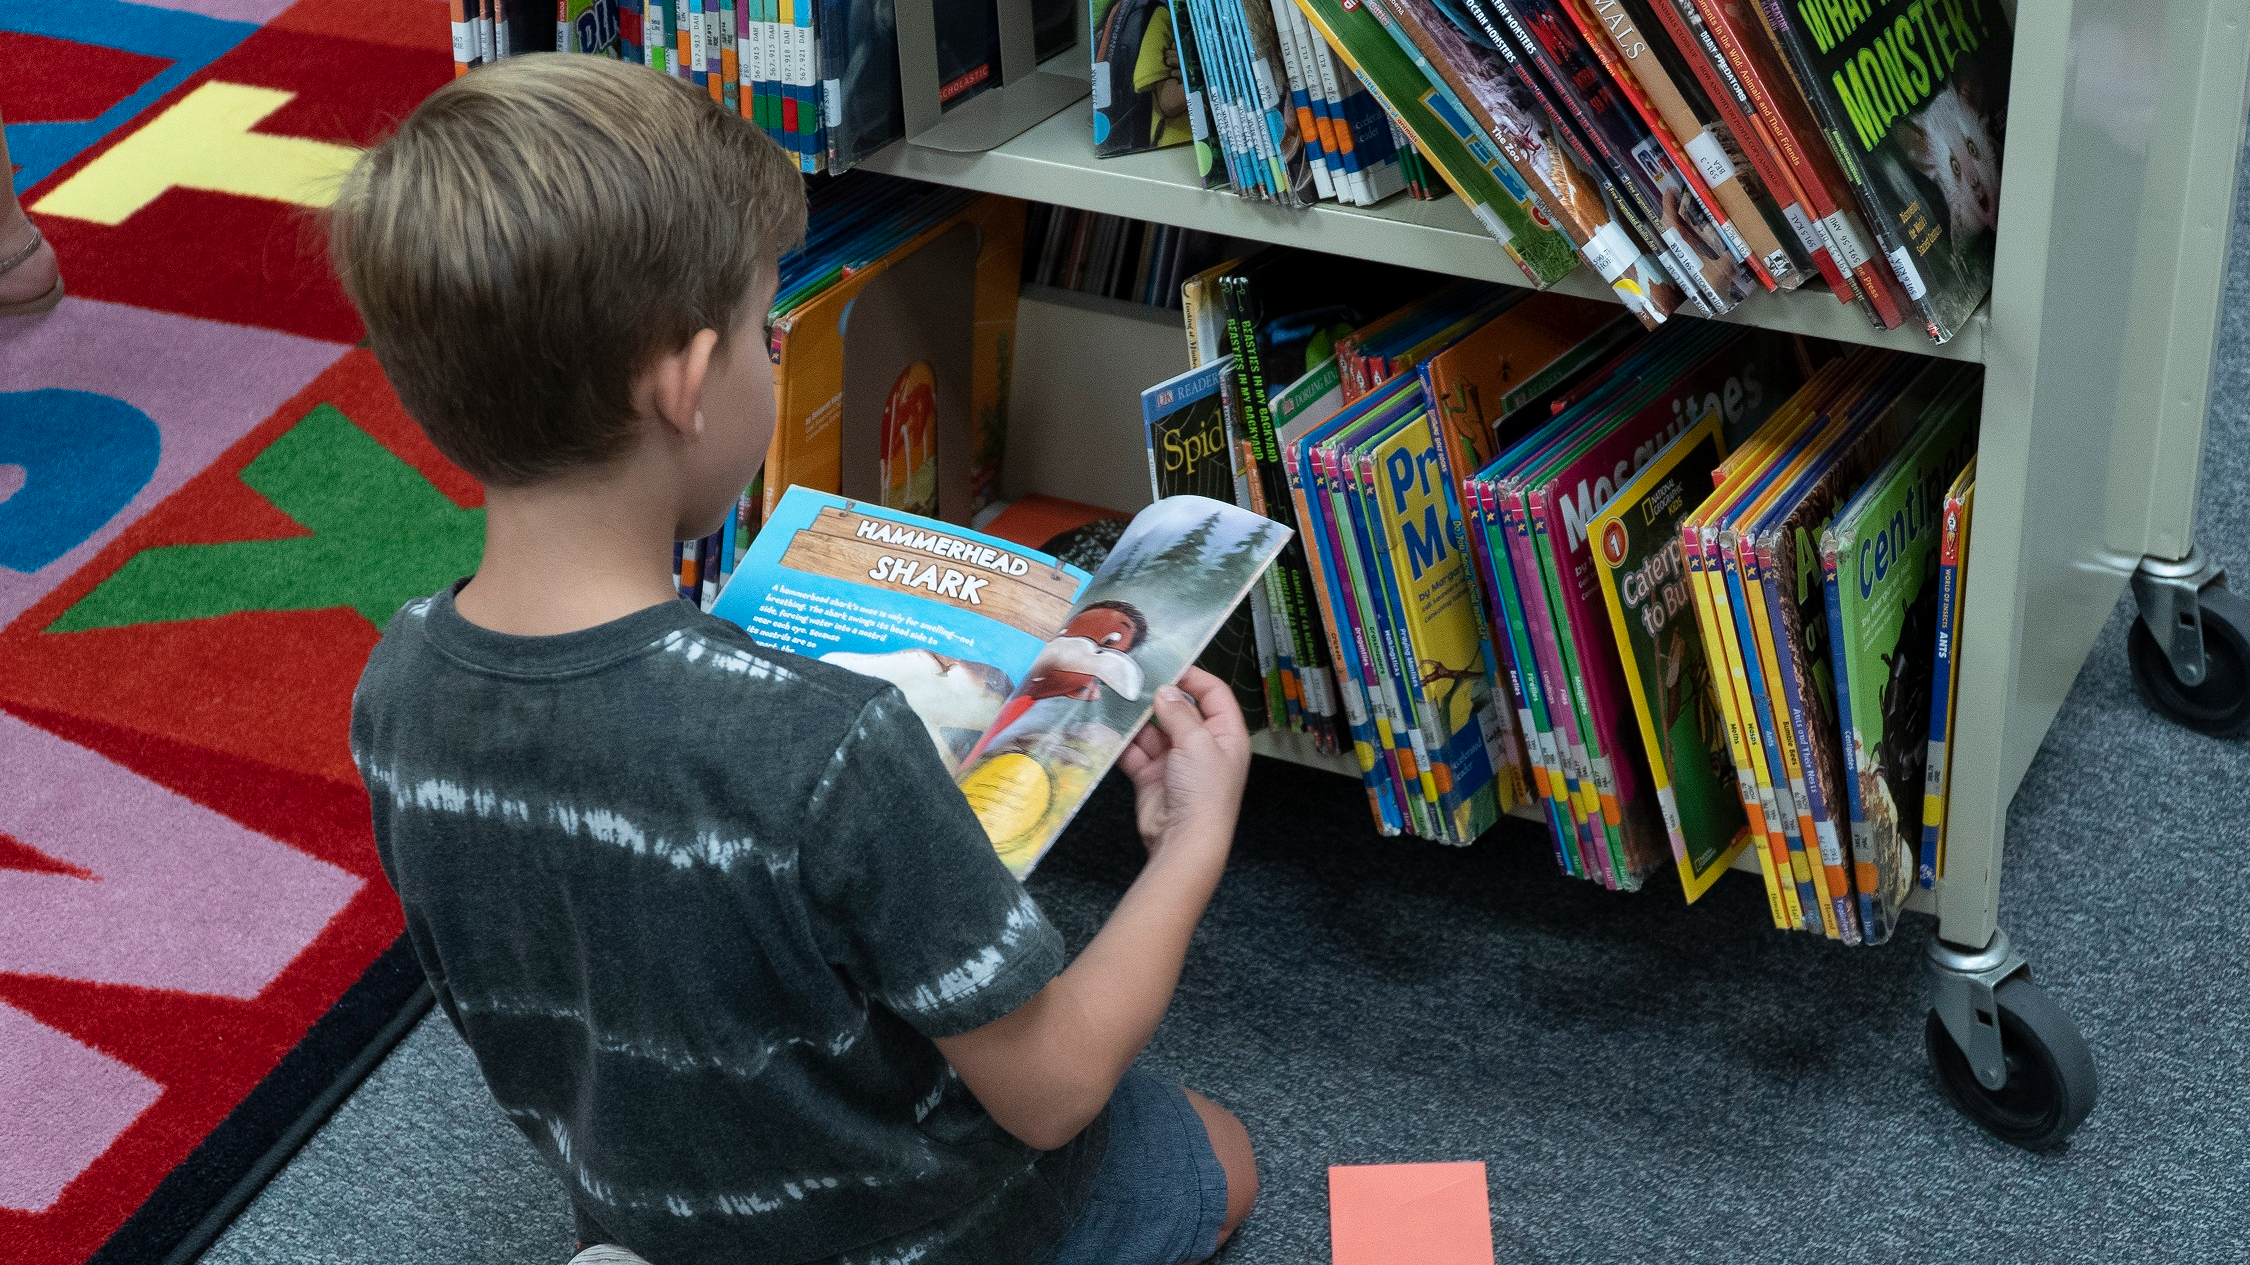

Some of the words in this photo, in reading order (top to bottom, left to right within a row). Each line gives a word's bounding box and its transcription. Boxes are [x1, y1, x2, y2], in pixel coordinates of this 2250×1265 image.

[1466, 2, 1488, 25] OCEAN
[1486, 24, 1516, 63] MONSTERS
[1505, 14, 1536, 55] MONSTERS
[1582, 31, 1599, 54] Animal
[1598, 53, 1616, 77] Clowns
[1700, 30, 1717, 54] DEADLY
[1715, 52, 1747, 102] PREDATORS
[1710, 78, 1720, 94] AND
[1715, 25, 1722, 35] in
[1720, 33, 1731, 49] the
[1729, 48, 1743, 69] Wild:
[1740, 69, 1761, 101] Animals
[1759, 101, 1770, 116] and
[1769, 117, 1783, 137] Their
[1780, 136, 1800, 166] Friends
[1356, 68, 1363, 80] my
[1364, 79, 1378, 96] little
[1378, 96, 1391, 111] book
[1391, 110, 1399, 118] of
[1397, 119, 1418, 143] animals
[1491, 126, 1507, 145] The
[1504, 145, 1520, 162] Zoo
[1700, 157, 1718, 179] 591.3
[1715, 160, 1726, 175] BEA
[1626, 181, 1637, 195] Free
[1608, 187, 1620, 203] Free
[1617, 198, 1638, 229] Augmented
[1636, 225, 1650, 244] Reality
[1647, 241, 1658, 251] App
[1792, 213, 1806, 231] KAL
[1829, 217, 1842, 232] AMU
[1738, 242, 1749, 255] 591
[1803, 230, 1816, 248] 591.5
[1819, 226, 1829, 243] DEL
[1671, 242, 1684, 259] CAR
[1828, 244, 1846, 273] 591.53
[1842, 235, 1860, 264] 591.56
[1666, 263, 1680, 281] CAR
[1683, 258, 1694, 271] 591
[1678, 279, 1690, 292] 591
[1863, 276, 1879, 298] Press
[1902, 276, 1917, 295] 591.6
[1227, 319, 1244, 370] BEASTIES
[1242, 320, 1260, 372] BEASTIES
[1239, 373, 1248, 385] IN
[1252, 376, 1263, 386] IN
[1240, 388, 1250, 404] MY
[1255, 389, 1266, 404] MY
[1164, 411, 1227, 475] Spid
[1244, 406, 1263, 461] BACKYARD
[1259, 408, 1279, 463] BACKYARD
[1386, 446, 1437, 515] Pr
[1650, 478, 1675, 507] NATIONAL
[1452, 520, 1461, 532] Do
[856, 519, 1029, 578] HAMMERHEAD
[1609, 534, 1621, 558] 1
[867, 554, 989, 607] SHARK
[765, 593, 808, 611] breathing.
[810, 604, 825, 614] The
[824, 608, 848, 621] shark
[848, 615, 877, 627] swings
[877, 621, 890, 631] its
[890, 623, 911, 637] head
[911, 630, 928, 642] side
[928, 636, 939, 646] to
[781, 585, 831, 604] hammerhead
[830, 597, 860, 611] shark's
[861, 606, 879, 616] nose
[880, 609, 887, 617] is
[888, 612, 906, 624] only
[906, 616, 920, 626] for
[1641, 602, 1664, 637] to
[747, 625, 760, 634] its
[761, 627, 792, 643] nostrils
[792, 636, 807, 646] are
[807, 640, 818, 649] so
[753, 615, 773, 625] near
[773, 618, 792, 631] each
[792, 625, 809, 635] eye.
[810, 628, 841, 642] Because
[760, 604, 779, 616] side,
[779, 608, 810, 624] forcing
[809, 617, 835, 628] water
[835, 622, 852, 632] into
[859, 627, 889, 642] nostril
[1330, 632, 1341, 661] Crickets
[1354, 627, 1370, 667] Dragonflies
[1369, 626, 1386, 675] Grasshoppers
[1384, 629, 1400, 677] Walkingsticks
[1400, 628, 1410, 659] Praying
[1407, 659, 1419, 687] Mantises
[1938, 631, 1948, 658] ANTS
[1510, 670, 1520, 696] Beetles
[1526, 672, 1538, 702] Fireflies
[1543, 670, 1555, 704] Ladybugs
[1560, 689, 1569, 705] Flies
[1574, 676, 1588, 715] Mosquitoes
[1730, 723, 1739, 745] Moths
[1748, 723, 1757, 746] Wasps
[1766, 730, 1774, 748] Ants
[1783, 721, 1793, 748] Bumble
[1788, 748, 1797, 766] Bees
[1793, 708, 1801, 726] Ants
[1797, 727, 1805, 744] and
[1801, 744, 1811, 768] Their
[1806, 770, 1817, 793] Nests
[1844, 730, 1855, 770] Centipedes
[1770, 893, 1781, 919] Howard
[1790, 905, 1799, 921] Hall
